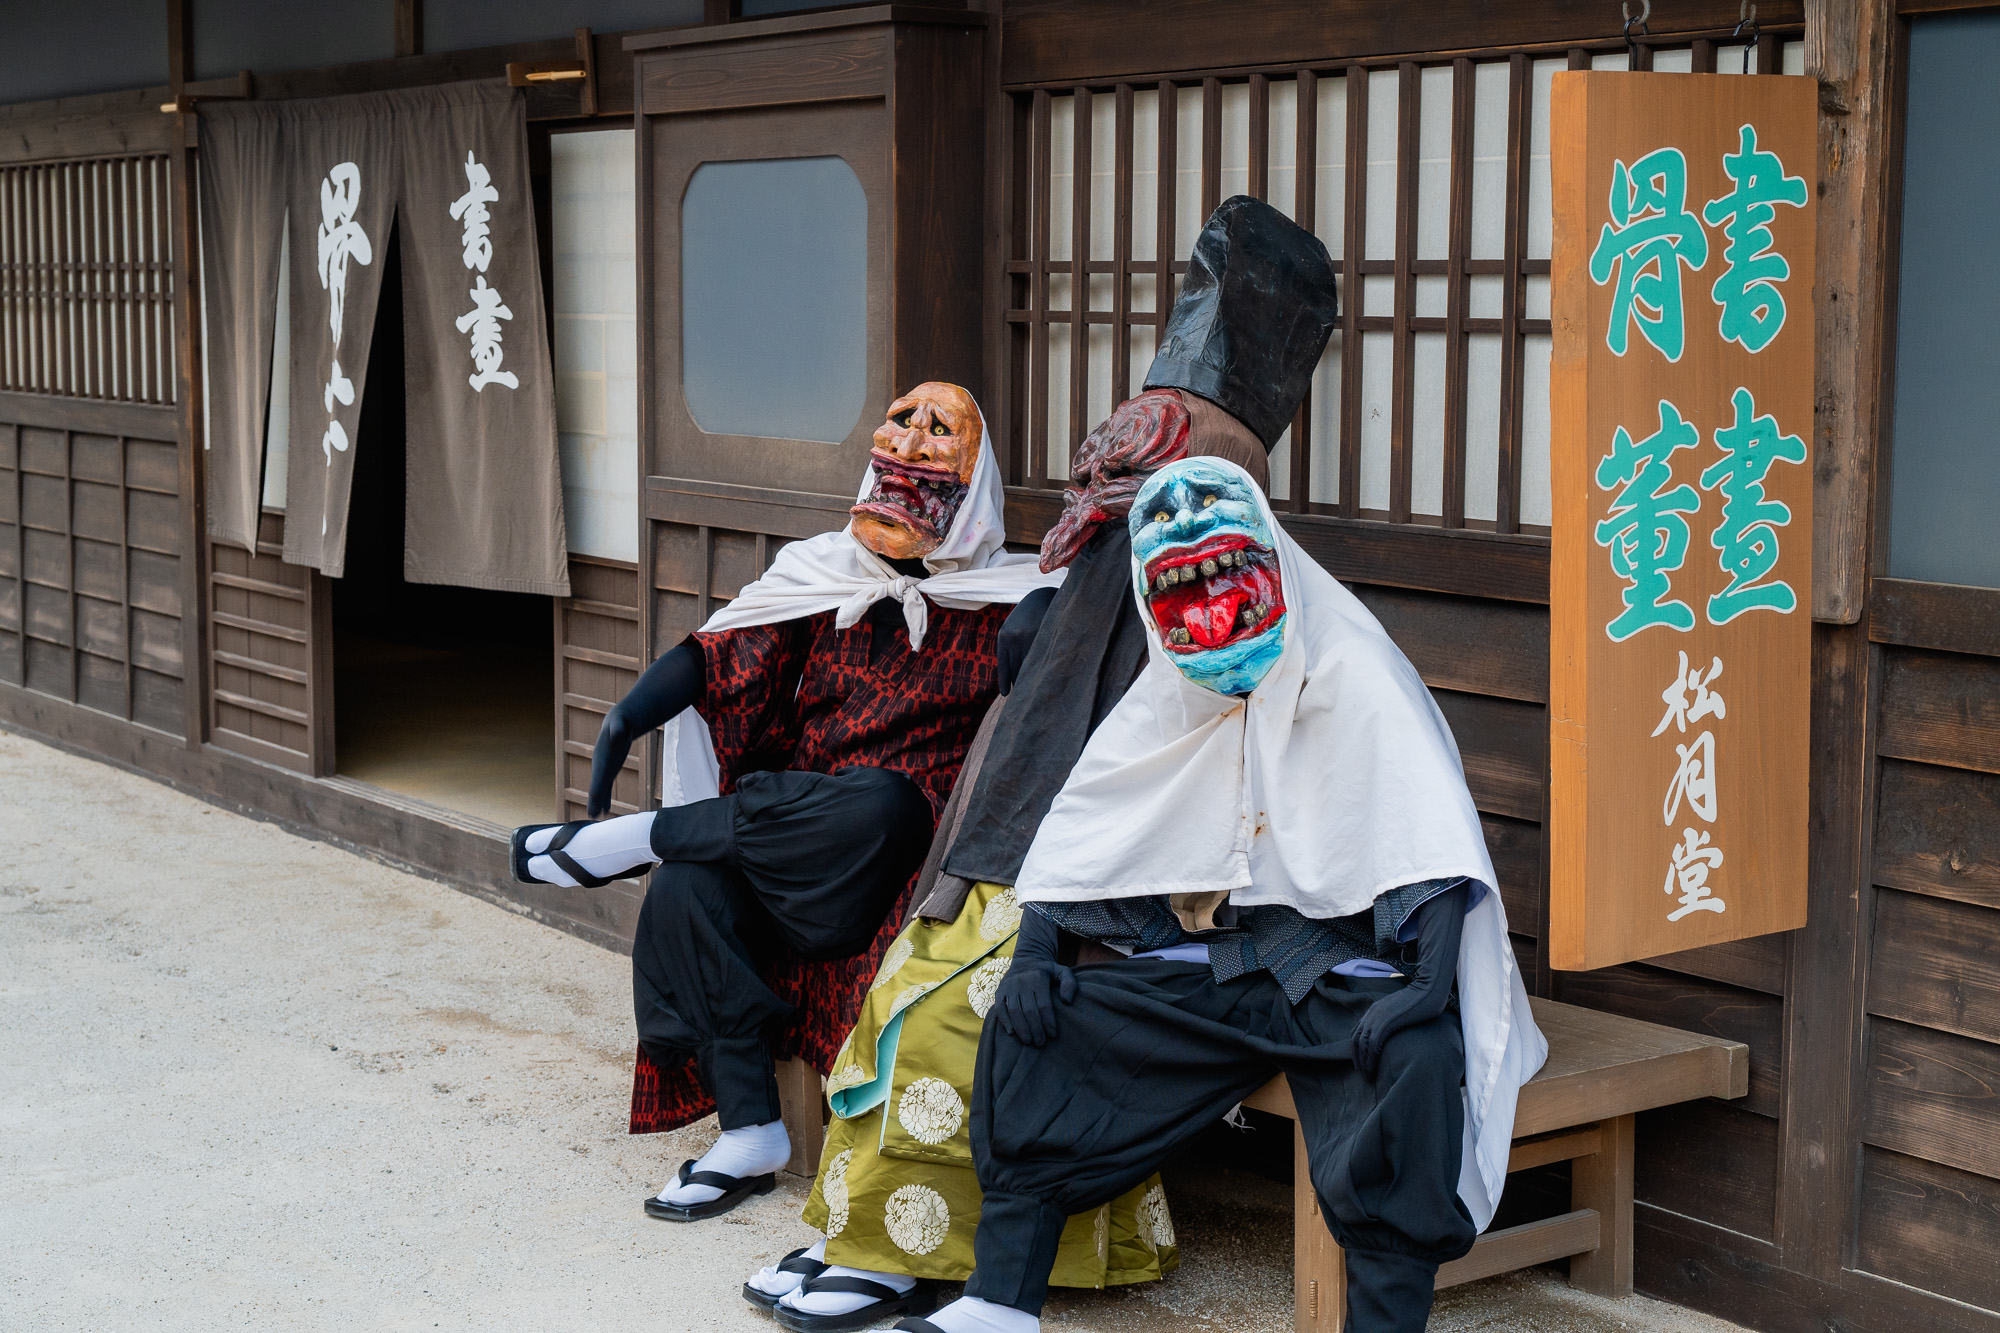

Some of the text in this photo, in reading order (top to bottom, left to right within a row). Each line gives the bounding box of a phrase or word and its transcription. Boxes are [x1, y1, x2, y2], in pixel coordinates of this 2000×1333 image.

[1589, 146, 1709, 643] 骨董
[1651, 649, 1727, 922] 松月堂
